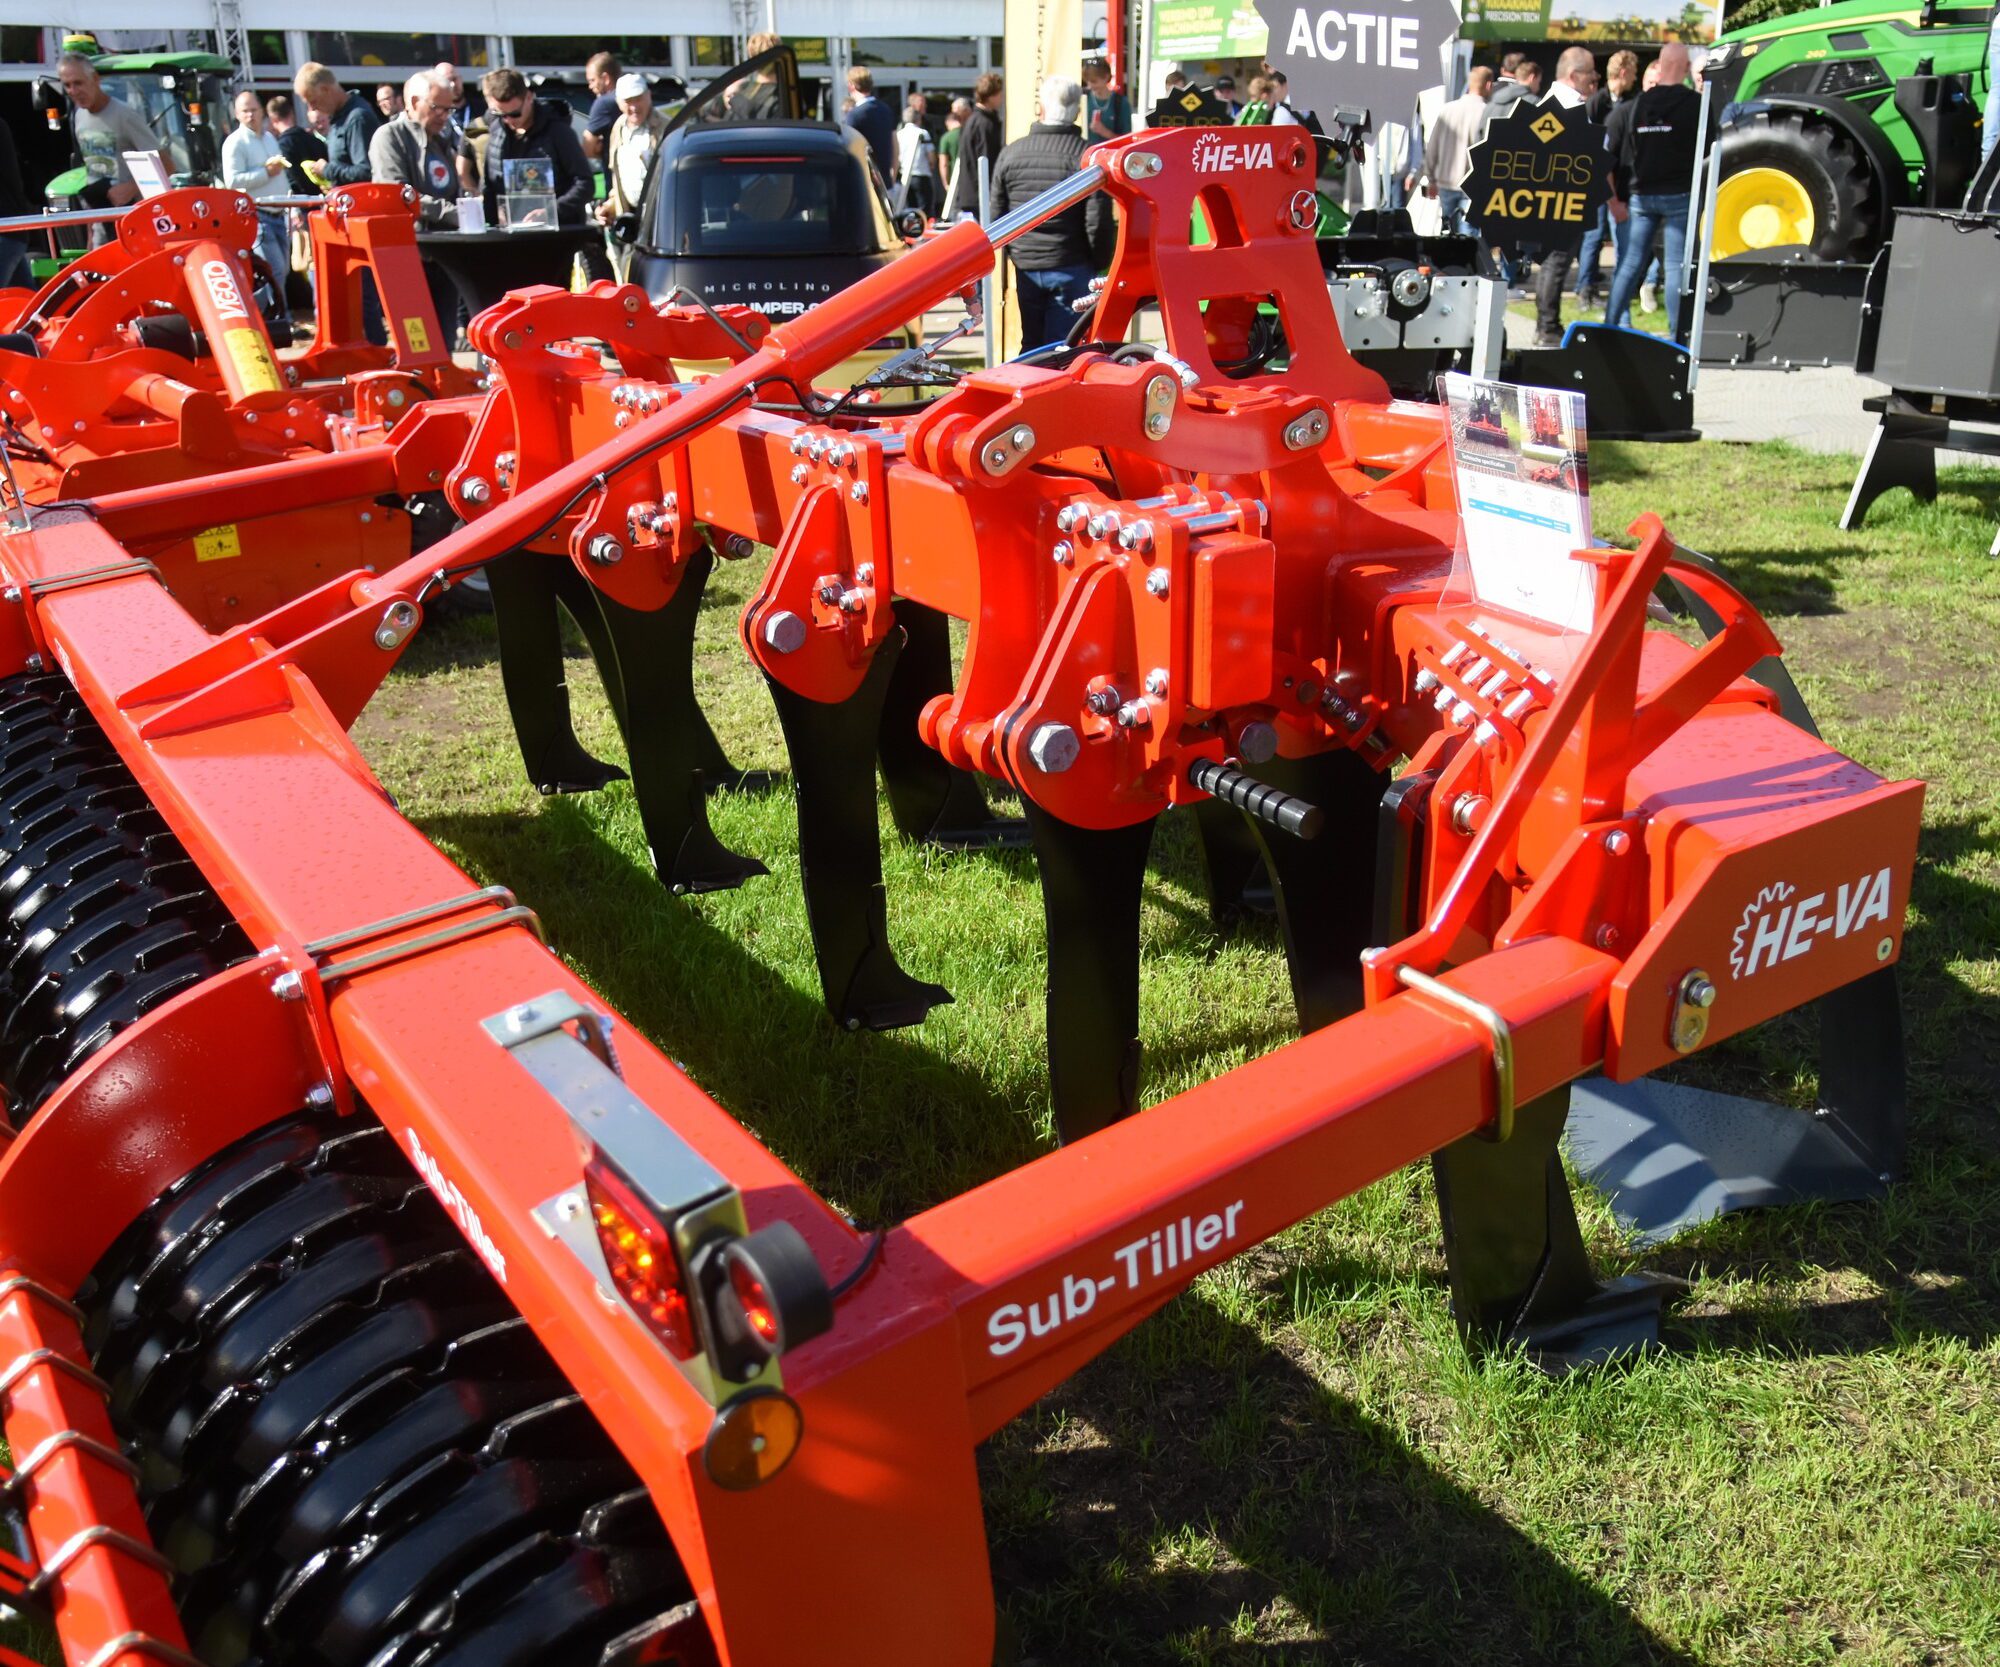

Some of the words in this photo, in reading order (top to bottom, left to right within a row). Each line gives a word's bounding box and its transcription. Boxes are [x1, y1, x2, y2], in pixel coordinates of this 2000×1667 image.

[1286, 8, 1419, 69] ACTIE
[1200, 143, 1274, 172] HE-VA
[1490, 149, 1593, 185] BEURS
[1483, 188, 1587, 222] ACTIE
[704, 282, 830, 294] MICROLINO
[1744, 866, 1891, 977] HE-VA
[407, 1127, 507, 1283] Sub-Tiller
[987, 1199, 1244, 1356] Sub-Tiller
